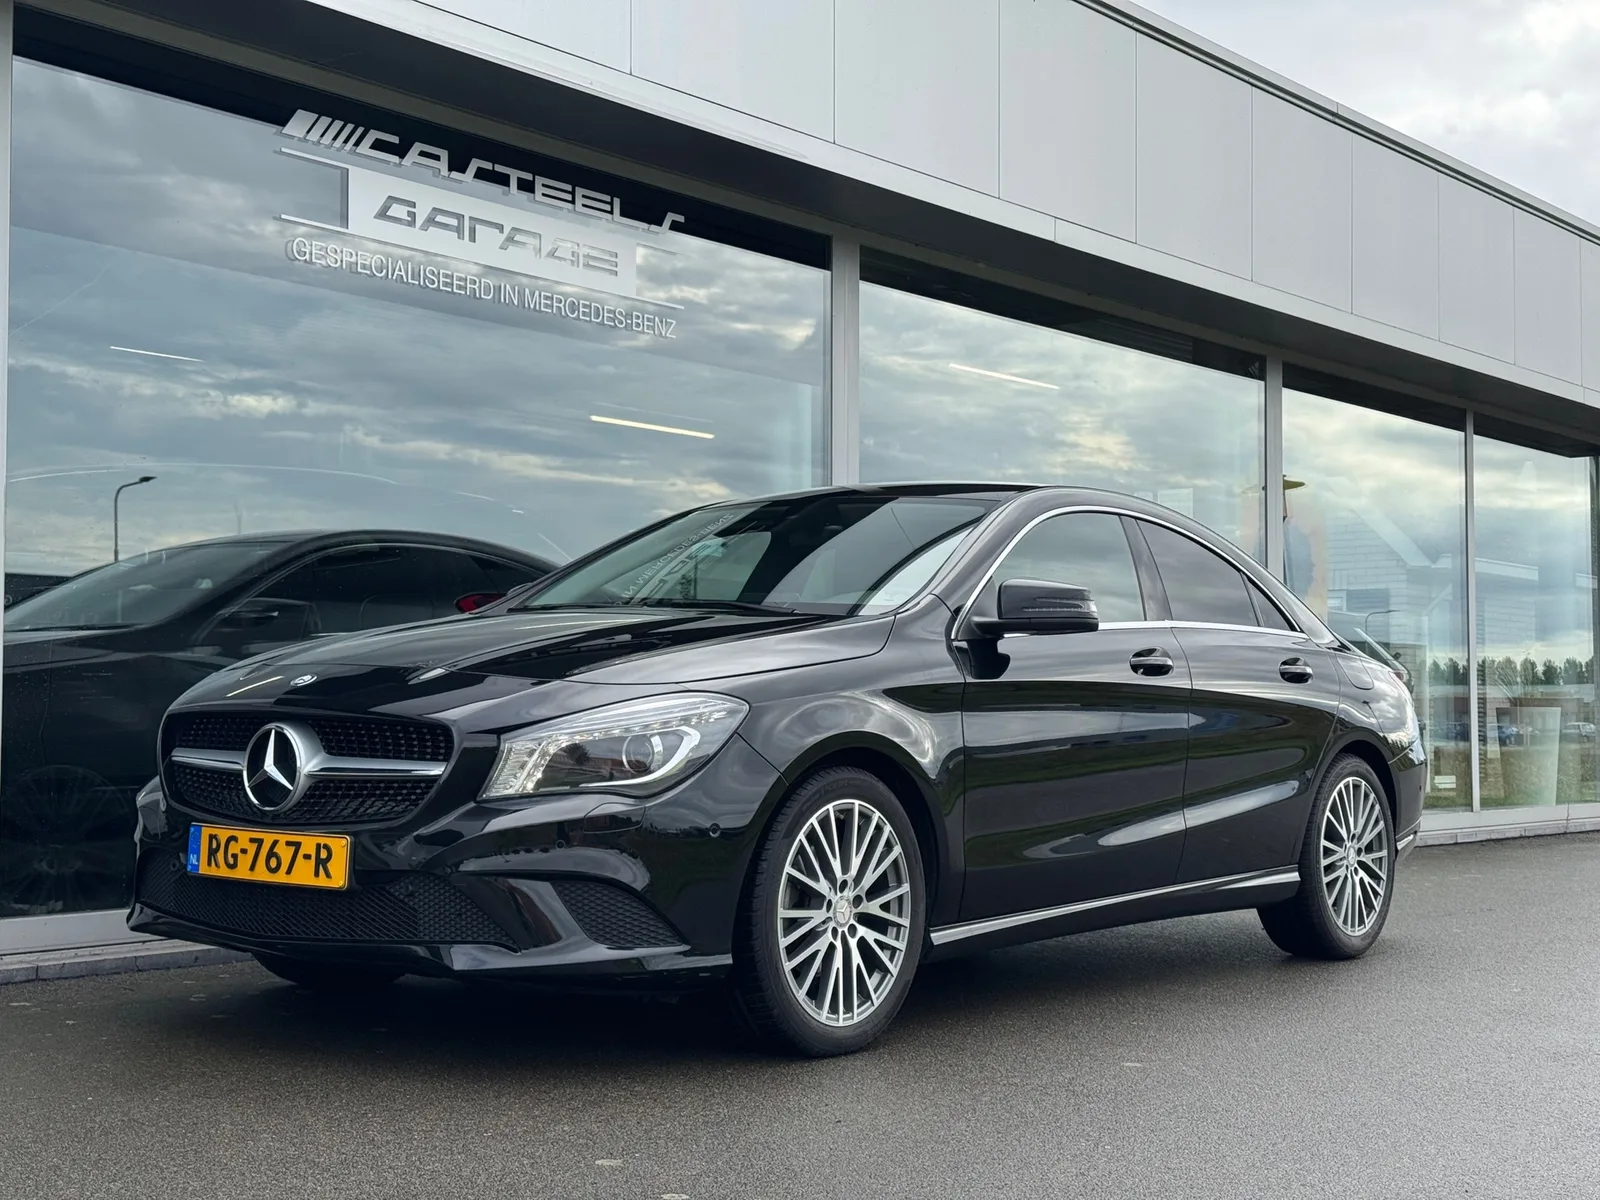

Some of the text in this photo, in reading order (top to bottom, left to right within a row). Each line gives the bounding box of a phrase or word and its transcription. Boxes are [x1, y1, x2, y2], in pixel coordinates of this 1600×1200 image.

[355, 129, 685, 234] CASTEELS
[373, 194, 619, 277] GARAGE
[291, 236, 677, 339] GESPECIALISEERD IN MERCEDES-BENZ
[190, 855, 199, 866] NL
[207, 833, 333, 879] RG-767-R
